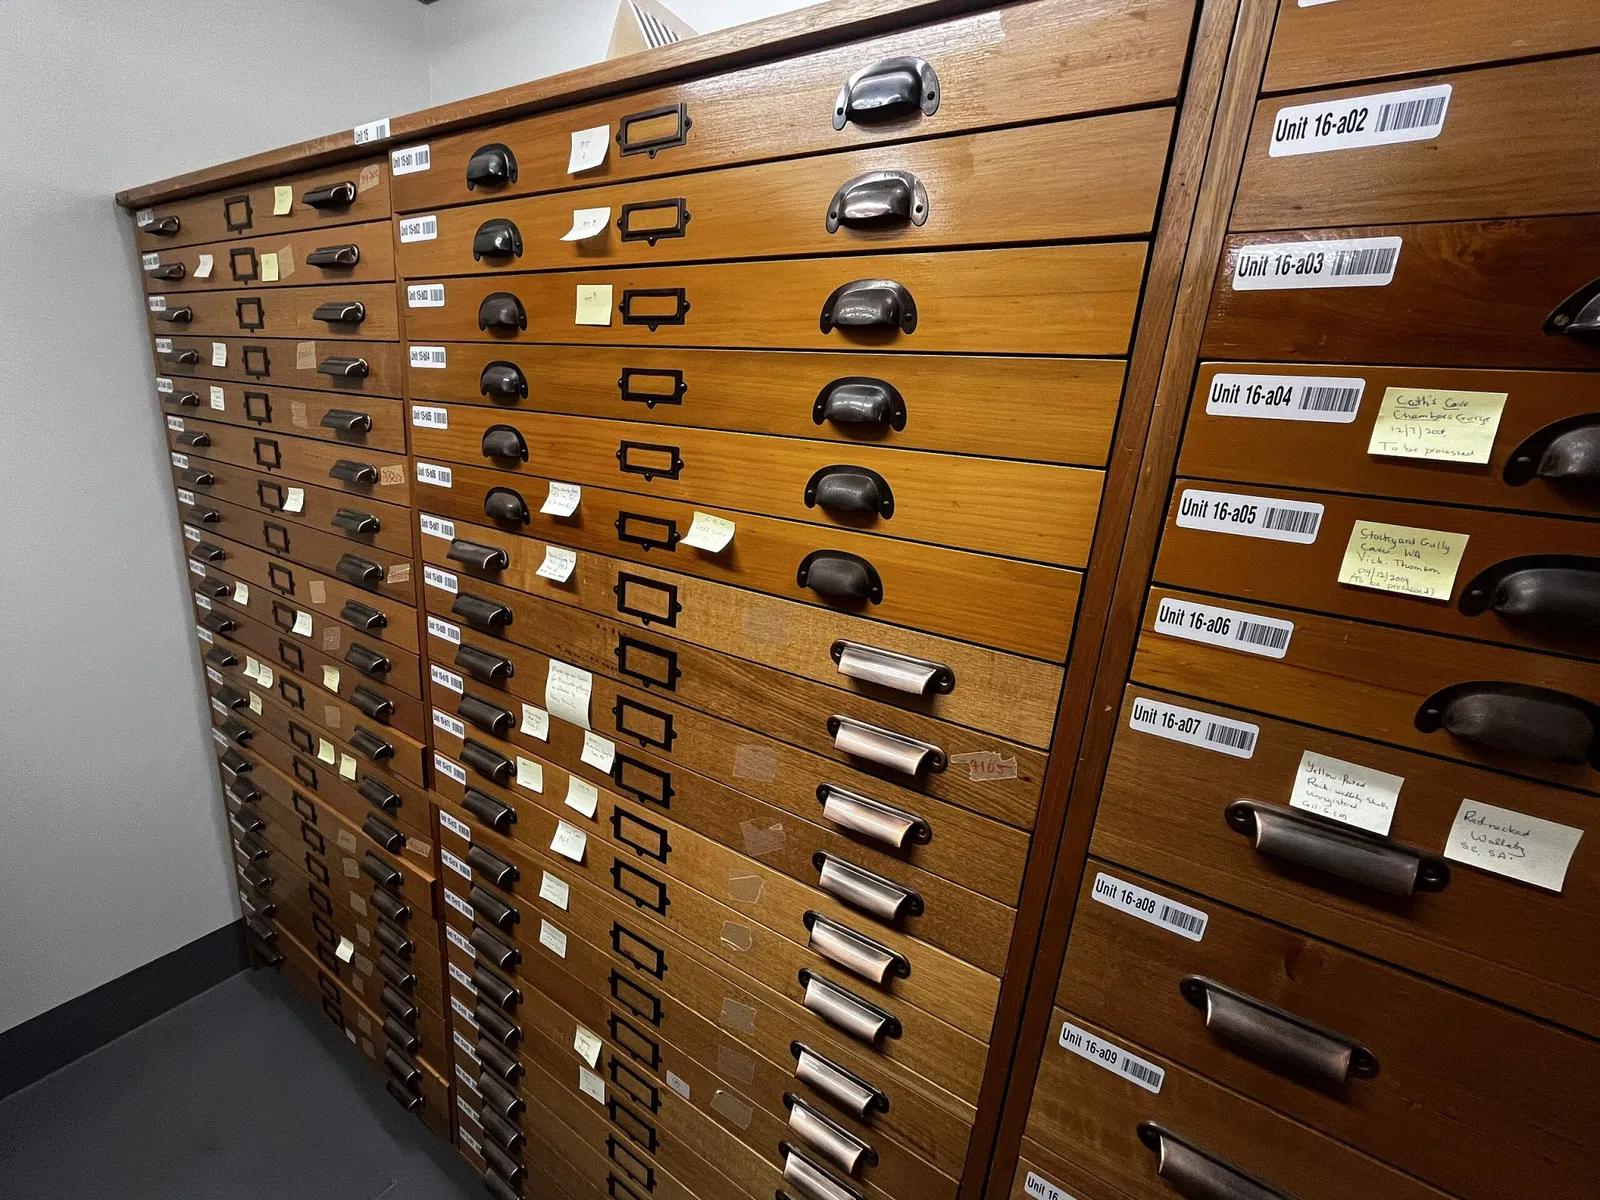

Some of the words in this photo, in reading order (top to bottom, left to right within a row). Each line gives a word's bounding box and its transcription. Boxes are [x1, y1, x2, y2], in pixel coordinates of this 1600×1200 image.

[1275, 116, 1308, 142] Unit
[1314, 107, 1368, 137] 16-a02
[1238, 254, 1268, 278] Unit
[1274, 252, 1324, 276] 16-a03
[1211, 383, 1240, 405] Unit
[1245, 384, 1293, 406] 16-a04
[1377, 441, 1398, 452] To
[1404, 443, 1419, 453] be
[1424, 447, 1474, 457] processed
[1181, 497, 1208, 520] Unit
[1212, 500, 1258, 525] 16-a05
[1360, 528, 1415, 549] Stockyard
[1420, 538, 1451, 555] Gully
[1159, 606, 1185, 628] Unit
[1188, 611, 1231, 637] 16-a06
[1133, 704, 1158, 727] Unit
[1161, 712, 1201, 736] 16-a07
[1463, 810, 1531, 837] Red-necked
[1095, 878, 1117, 900] Unit
[1121, 888, 1156, 914] 16-a08
[1062, 1027, 1082, 1049] Unit
[1085, 1038, 1117, 1065] 16-a09
[1028, 1176, 1046, 1196] Unit
